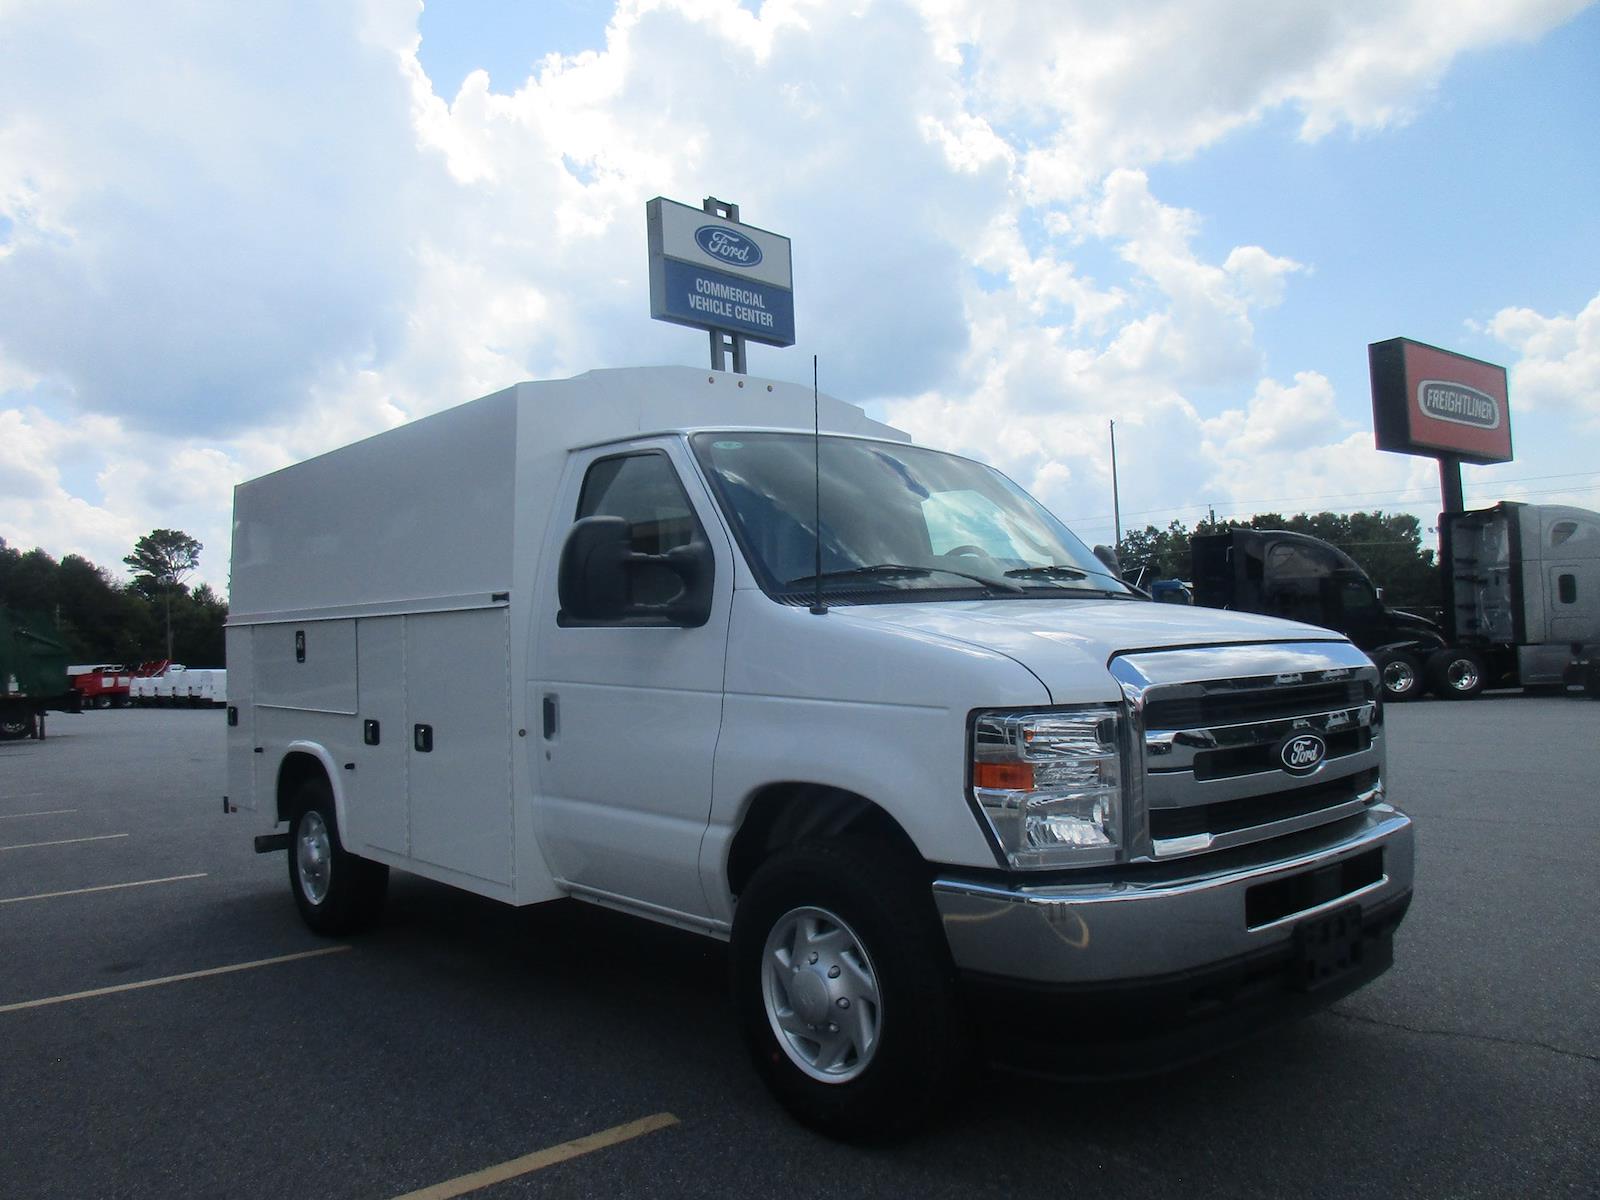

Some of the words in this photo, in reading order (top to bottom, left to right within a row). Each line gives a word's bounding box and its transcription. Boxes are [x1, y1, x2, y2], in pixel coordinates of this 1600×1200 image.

[708, 231, 750, 262] Ford
[695, 278, 766, 309] COMMERCIAL
[688, 293, 733, 318] VEHICLE
[734, 305, 774, 328] CENTER
[1426, 389, 1493, 420] FREIGHTLINER
[1290, 740, 1318, 765] Ford
